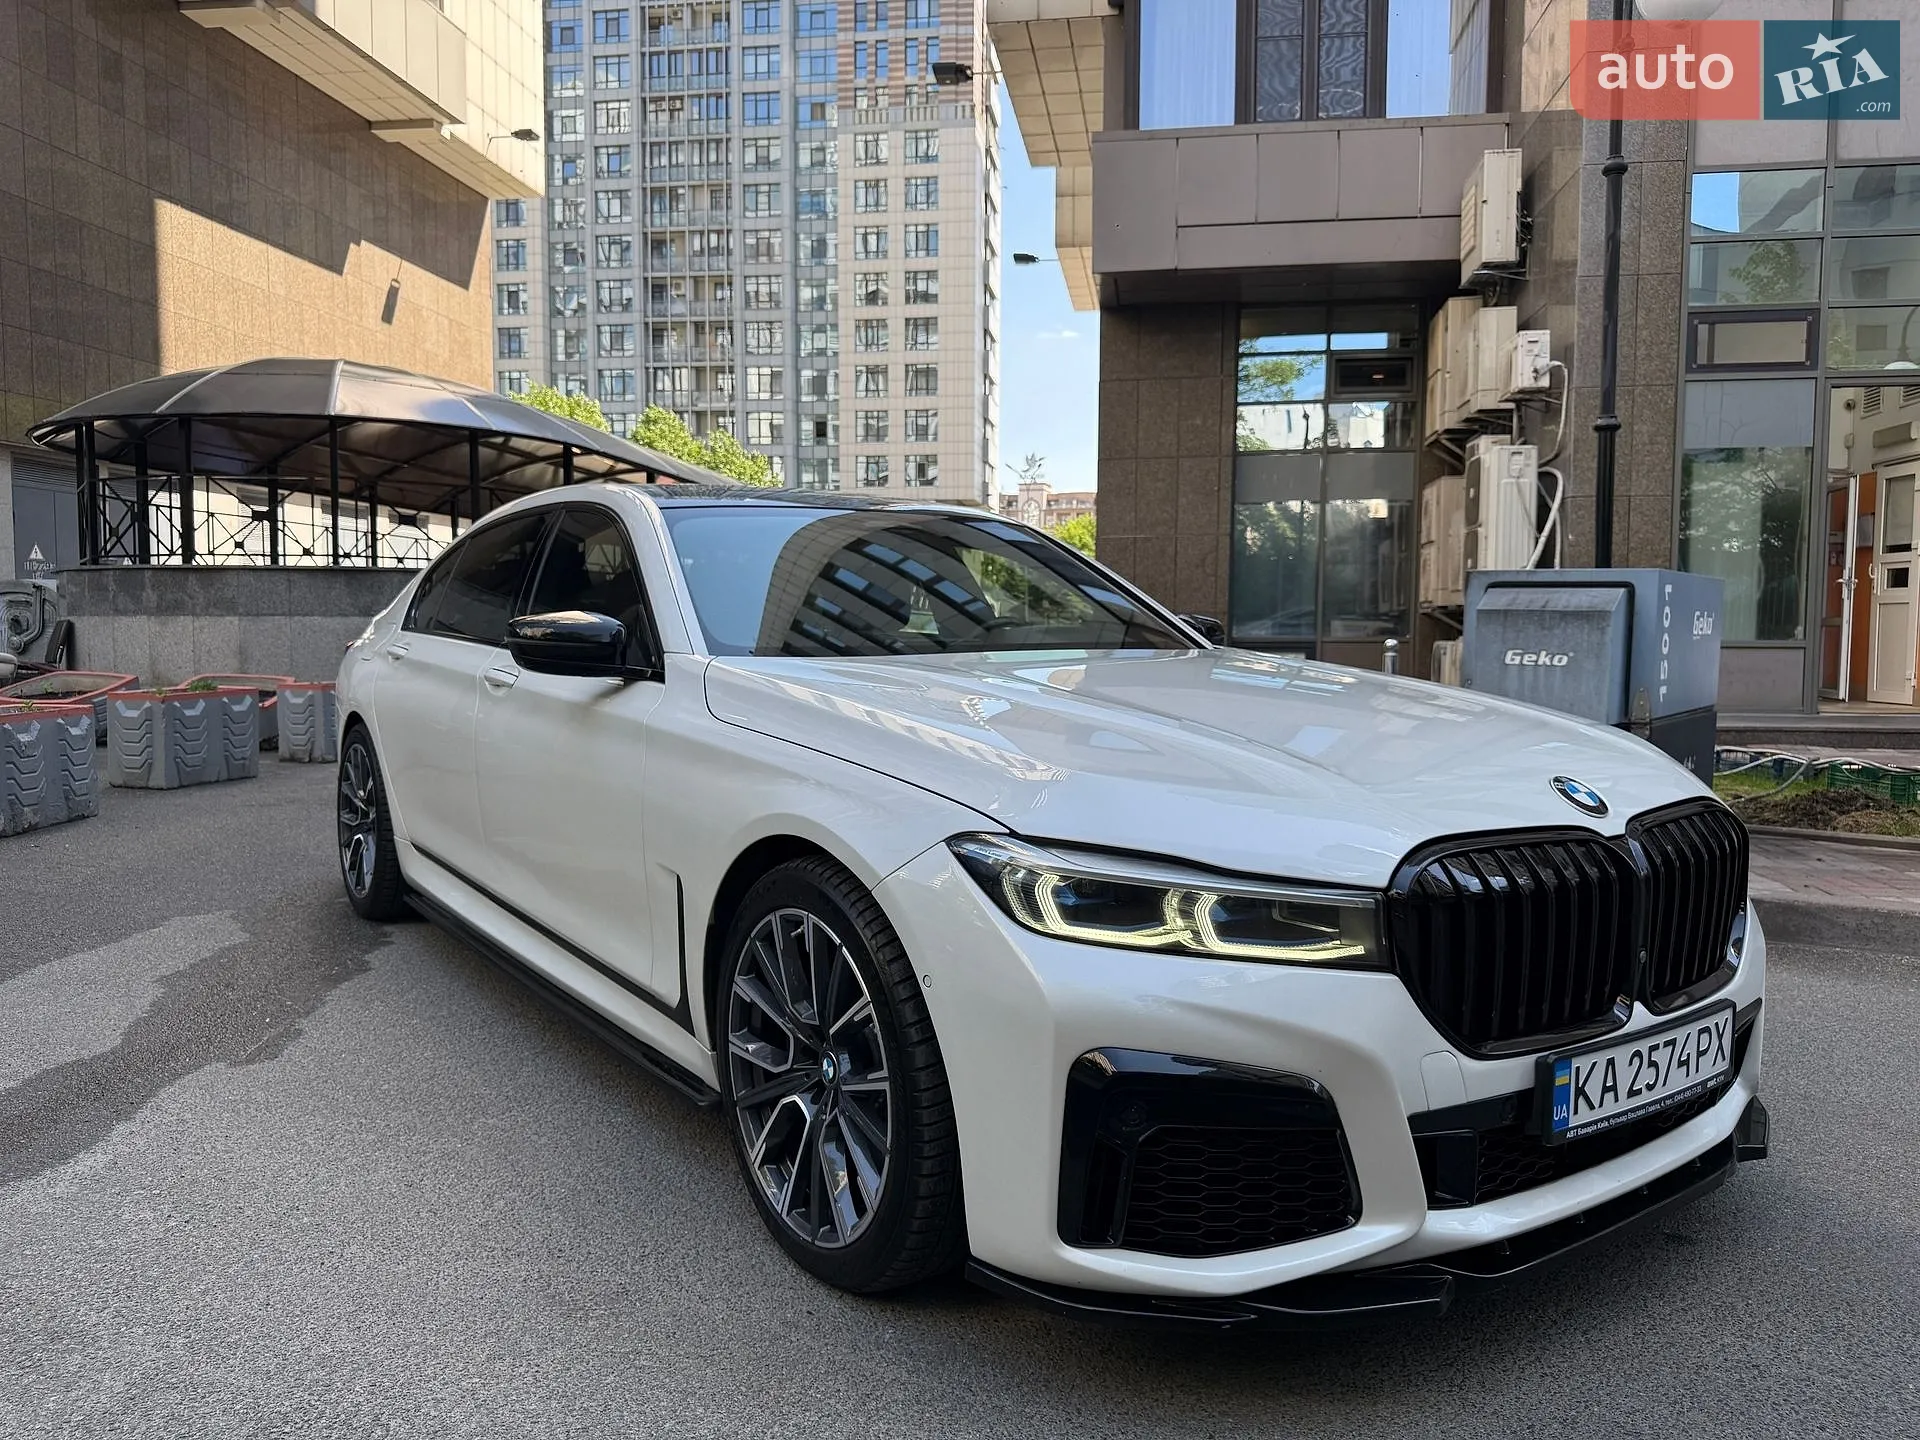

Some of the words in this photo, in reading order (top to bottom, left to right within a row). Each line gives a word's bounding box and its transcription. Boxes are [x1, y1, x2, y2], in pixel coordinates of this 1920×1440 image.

[1692, 610, 1713, 635] Geko
[1504, 649, 1569, 666] Geko
[1573, 1056, 1619, 1115] KA
[1627, 1031, 1692, 1099] 2574
[1695, 1017, 1729, 1074] PX
[1553, 1104, 1568, 1120] UA
